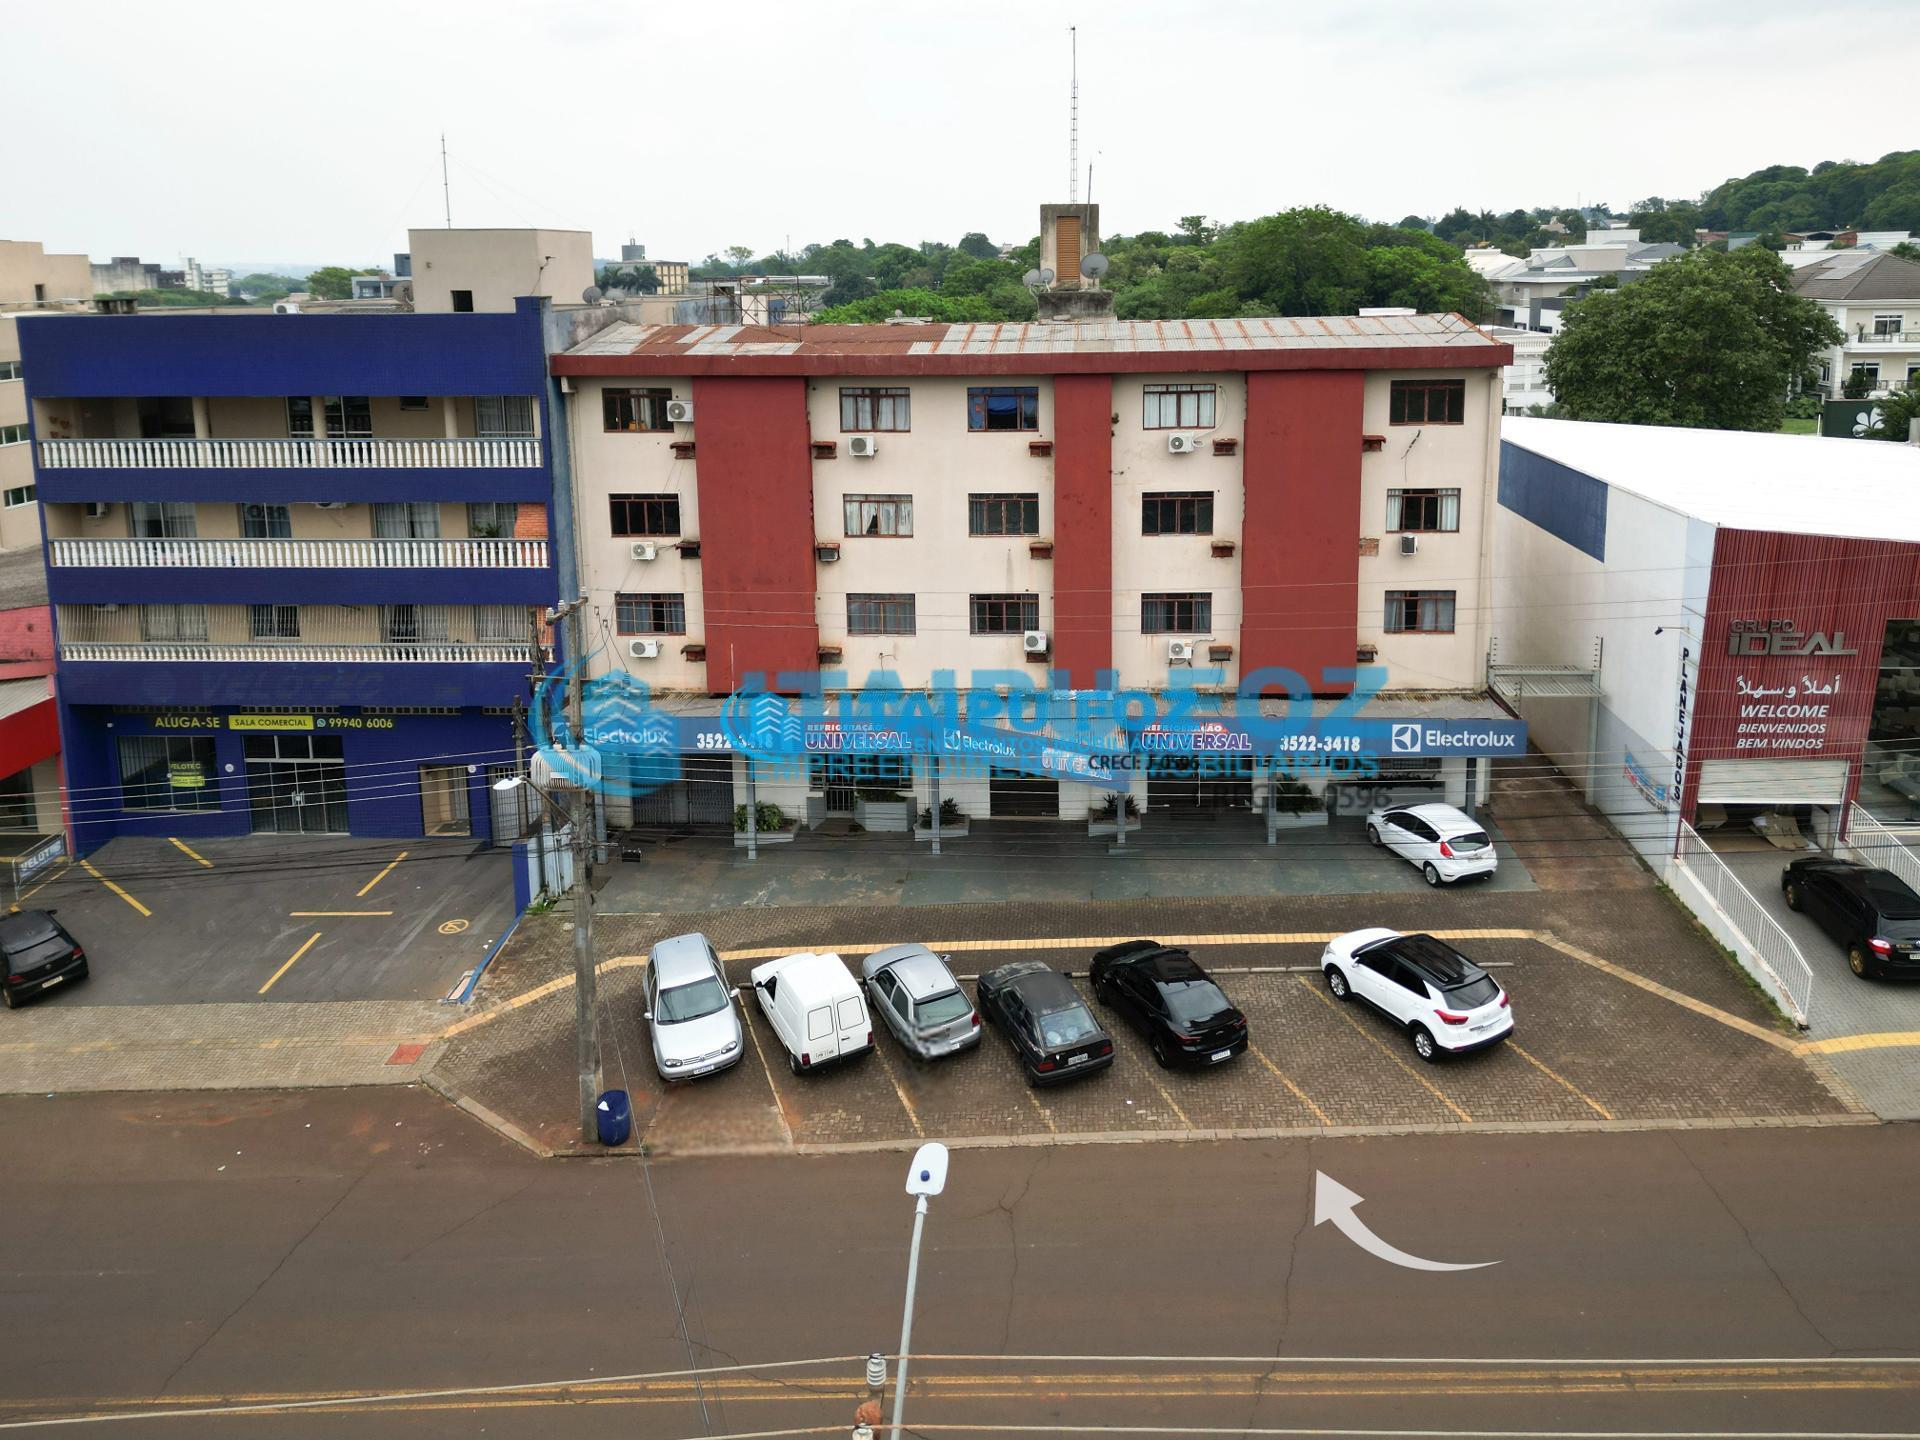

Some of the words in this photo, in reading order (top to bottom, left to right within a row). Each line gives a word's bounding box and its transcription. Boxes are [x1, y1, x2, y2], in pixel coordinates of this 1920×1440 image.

[1731, 619, 1795, 632] GRUPO
[1741, 704, 1830, 718] WELCOME
[155, 717, 221, 728] ALUGA-SE
[234, 718, 256, 727] SALA
[257, 718, 308, 727] COMERCIAL
[329, 718, 363, 728] 99940
[366, 718, 394, 728] 6006
[1673, 647, 1690, 801] PLANEJADOS
[1737, 723, 1827, 734] BIENVENIDOS
[584, 728, 671, 745] Electrolux
[805, 731, 912, 751] UNIVERSAL
[1142, 732, 1252, 751] UNIVERSAL
[1279, 735, 1361, 752] 3522-3418
[1426, 729, 1515, 748] Electrolux
[1736, 738, 1768, 749] BEM
[1771, 738, 1824, 749] VINDOS
[962, 735, 1016, 758] Electrolux
